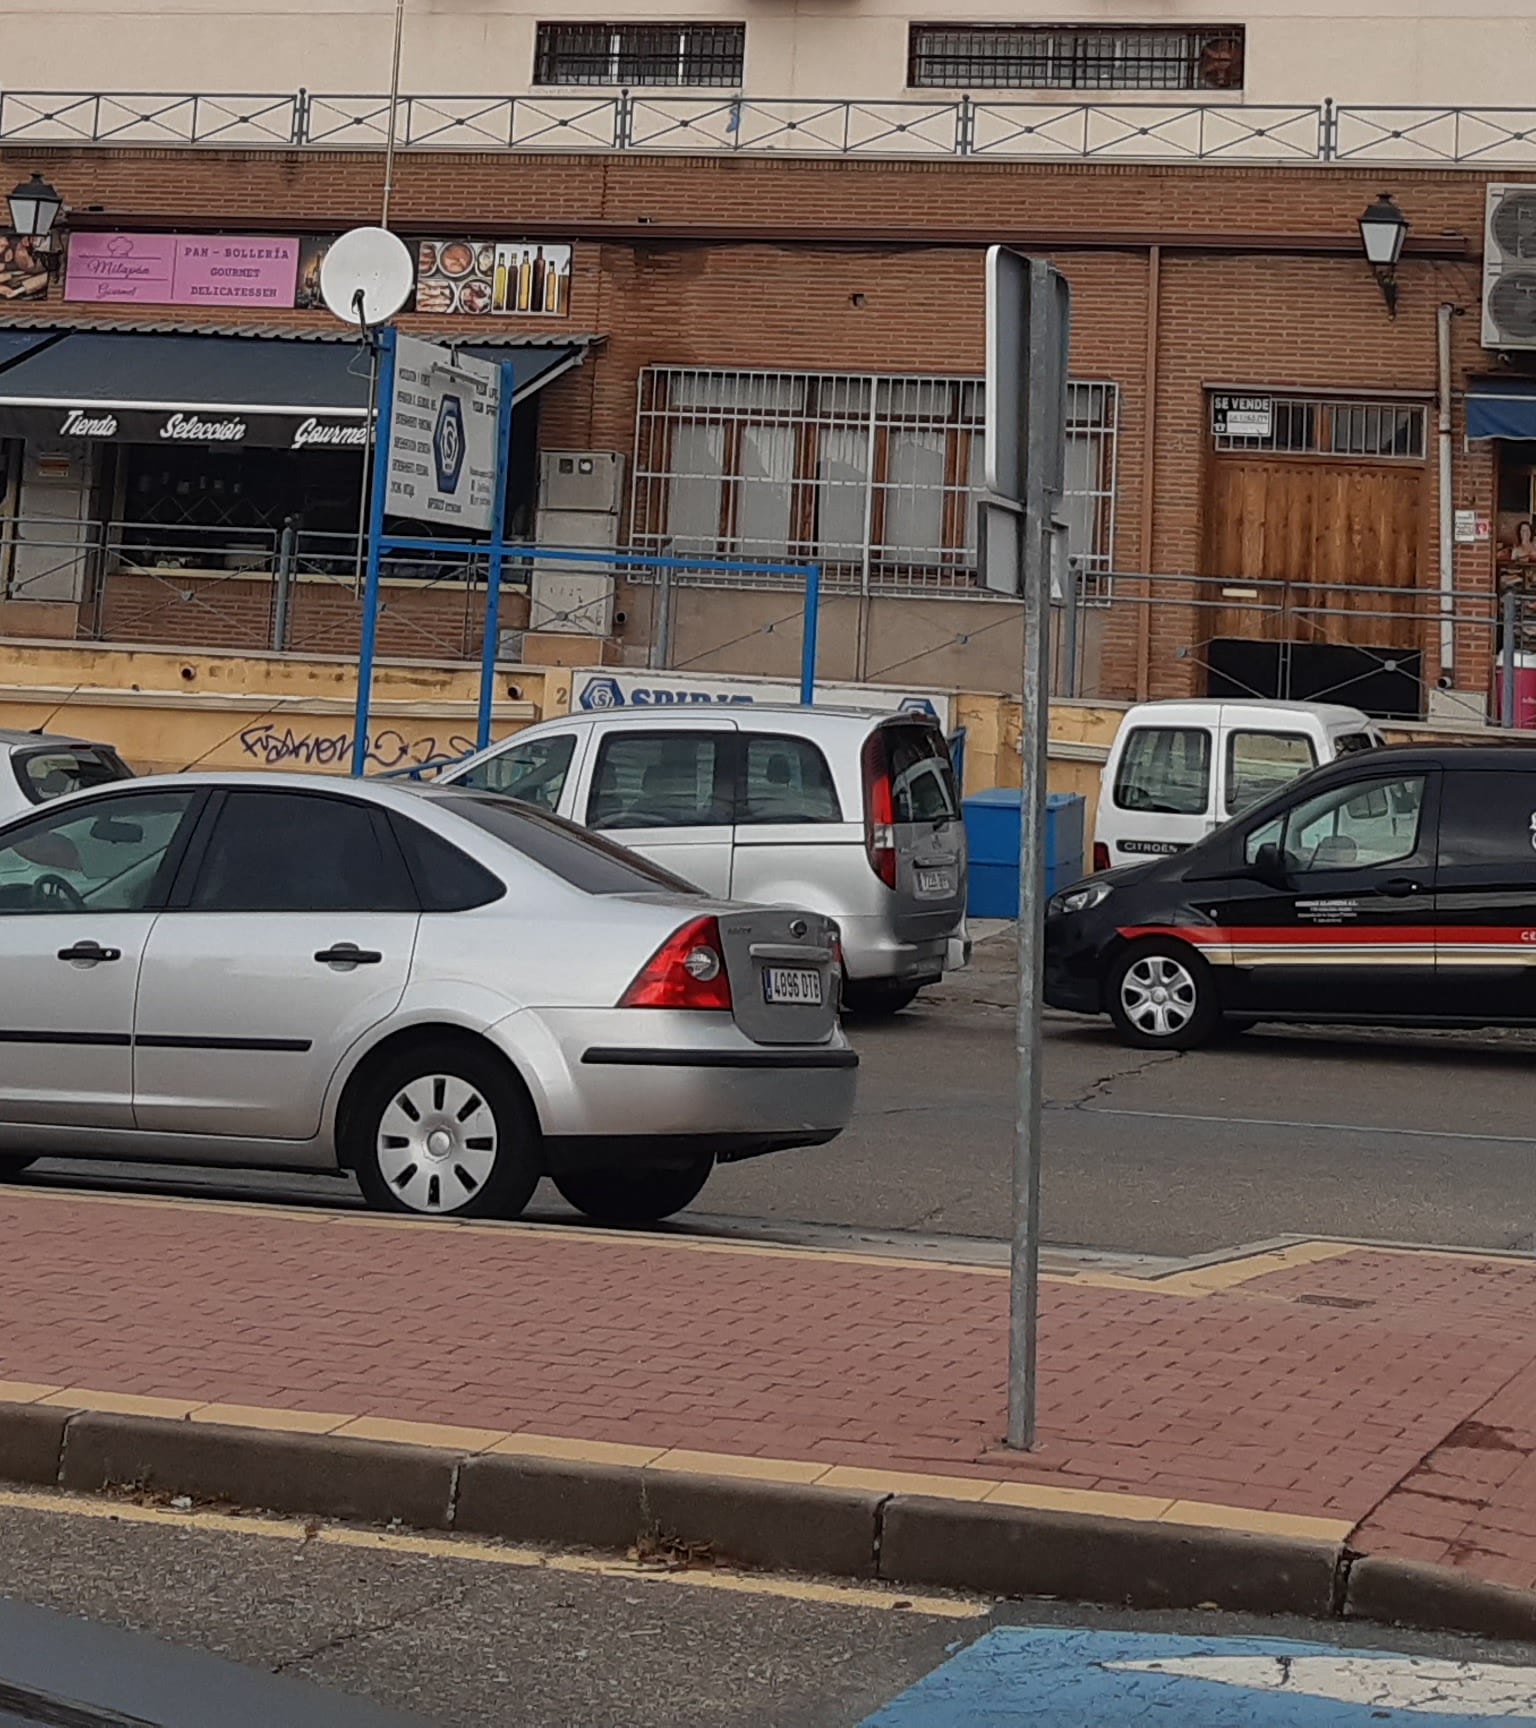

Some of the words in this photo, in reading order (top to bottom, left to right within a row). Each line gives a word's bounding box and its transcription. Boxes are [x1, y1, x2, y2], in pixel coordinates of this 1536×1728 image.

[184, 247, 208, 258] PAN
[225, 247, 289, 259] BOLLERÍA
[210, 268, 261, 278] GOURMET
[190, 286, 277, 298] DELICATESSEN
[1214, 396, 1229, 410] SE
[1232, 397, 1269, 410] VENDE
[59, 409, 118, 437] Tienda
[160, 413, 248, 441] Selección
[291, 417, 375, 449] Gourme
[556, 687, 567, 704] 2
